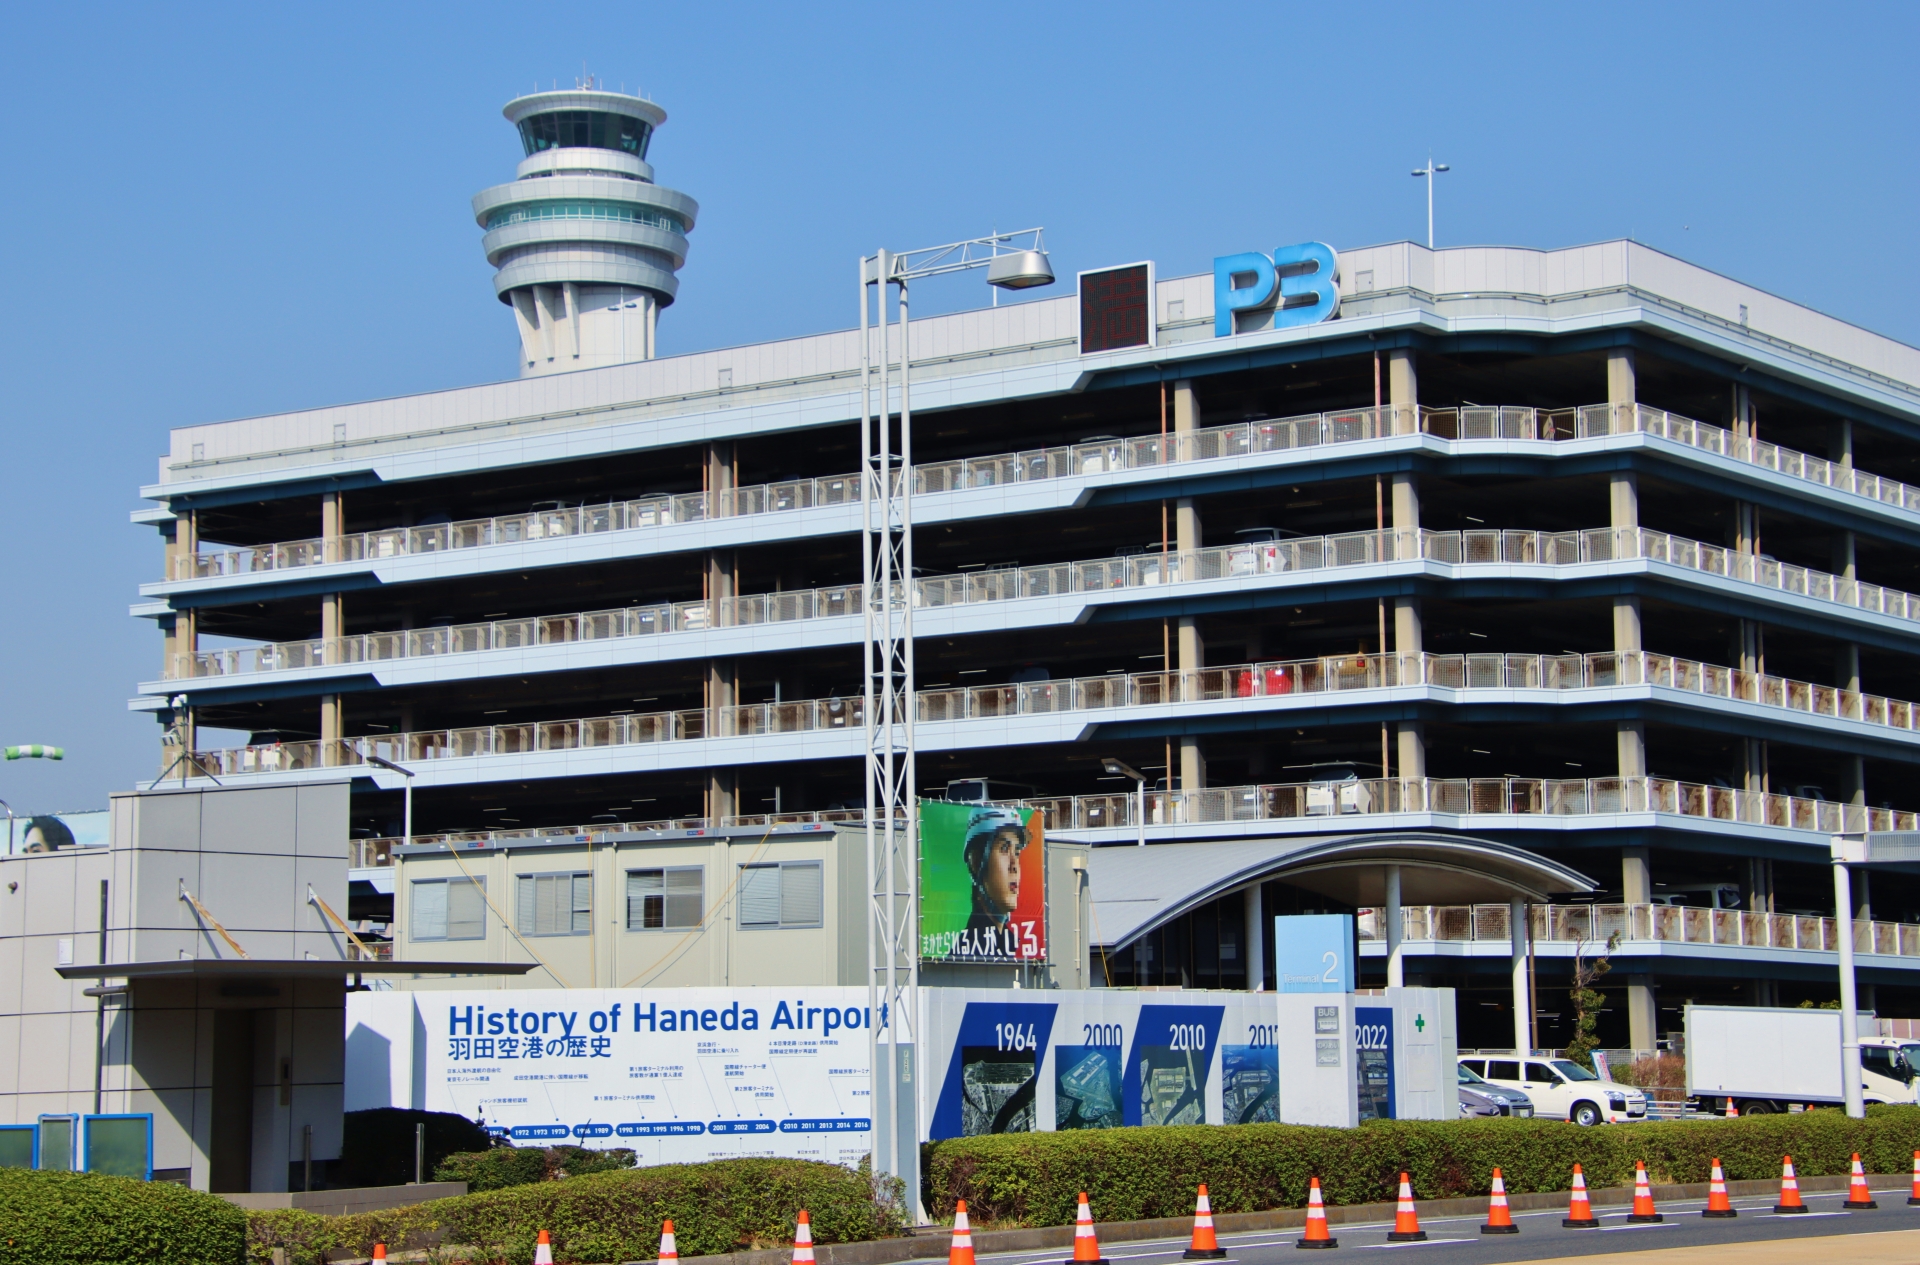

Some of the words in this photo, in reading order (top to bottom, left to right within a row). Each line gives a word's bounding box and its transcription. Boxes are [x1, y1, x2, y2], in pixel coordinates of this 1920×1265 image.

[1214, 241, 1340, 338] P3
[1282, 973, 1319, 983] Terminal
[1322, 950, 1339, 983] 2
[449, 1005, 578, 1041] History
[588, 1003, 621, 1033] of
[634, 1001, 759, 1032] Haneda
[1318, 1008, 1336, 1017] BUS
[448, 1035, 612, 1061] 羽田空港の歴史
[995, 1023, 1037, 1051] 1964
[1083, 1023, 1123, 1050] 2000
[1169, 1024, 1205, 1050] 2010
[1355, 1024, 1388, 1050] 2022
[515, 1128, 530, 1136] 1972
[533, 1128, 548, 1136] 1973
[551, 1127, 566, 1135] 1978
[594, 1126, 609, 1134] 1989
[619, 1126, 633, 1134] 1990
[653, 1125, 667, 1133] 1995
[687, 1124, 701, 1132] 1998
[733, 1123, 748, 1131] 2002
[755, 1122, 770, 1130] 2004
[783, 1122, 798, 1130] 2010
[819, 1121, 833, 1129] 2013
[836, 1121, 851, 1129] 2014
[854, 1120, 869, 1128] 2016
